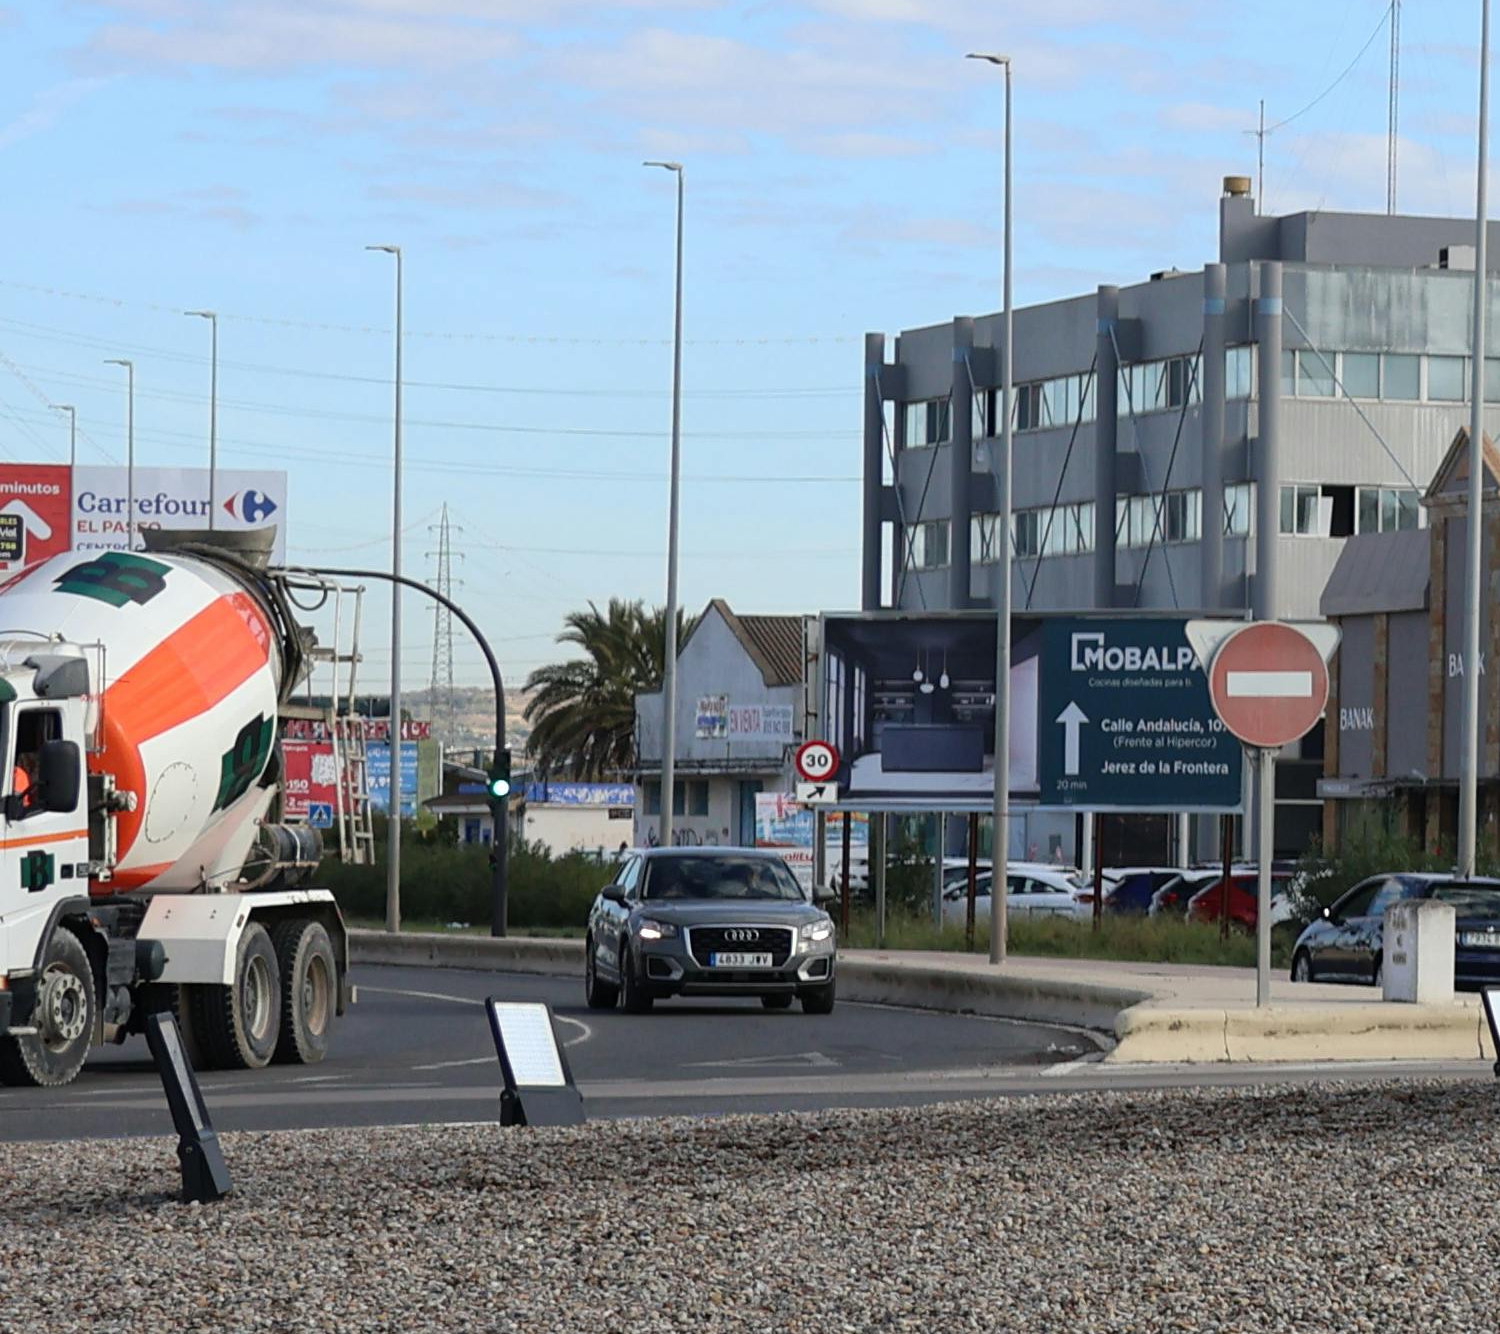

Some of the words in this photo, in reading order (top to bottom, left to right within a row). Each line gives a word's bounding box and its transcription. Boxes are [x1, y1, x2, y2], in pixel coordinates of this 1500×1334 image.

[0, 481, 60, 495] minutos
[77, 520, 96, 533] EL
[1449, 653, 1486, 677] BAK
[1088, 677, 1120, 687] Cocinas
[1164, 678, 1184, 688] para
[1101, 718, 1133, 732] Calle
[1136, 718, 1204, 733] Andalucía,
[1207, 719, 1226, 732] 10
[1340, 707, 1374, 731] BANAK
[1113, 736, 1152, 748] (Frente
[1155, 736, 1165, 747] al
[1167, 736, 1217, 749] Hipercor)
[806, 754, 828, 767] 30
[1101, 761, 1136, 774] Jerez
[1139, 761, 1156, 774] de
[1159, 761, 1171, 774] la
[1174, 761, 1229, 774] Frontera
[1056, 780, 1068, 790] 20
[1070, 780, 1087, 790] min
